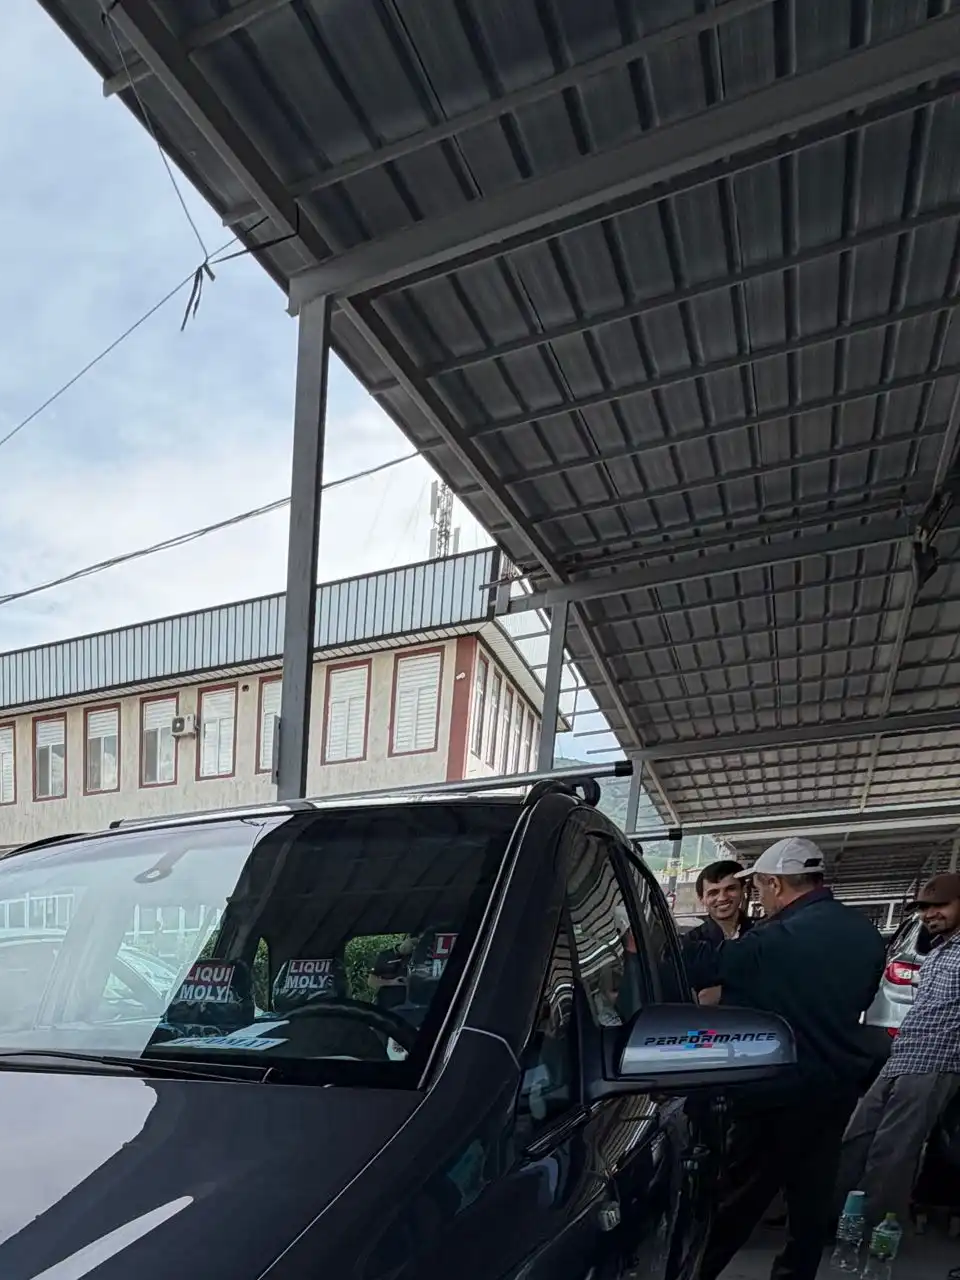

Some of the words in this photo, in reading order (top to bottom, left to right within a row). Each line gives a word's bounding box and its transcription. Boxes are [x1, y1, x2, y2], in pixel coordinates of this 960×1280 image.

[290, 961, 330, 974] LIQUI
[286, 974, 328, 989] MOLY
[179, 984, 227, 1001] MOLY
[644, 1032, 777, 1046] PERFORMANCE
